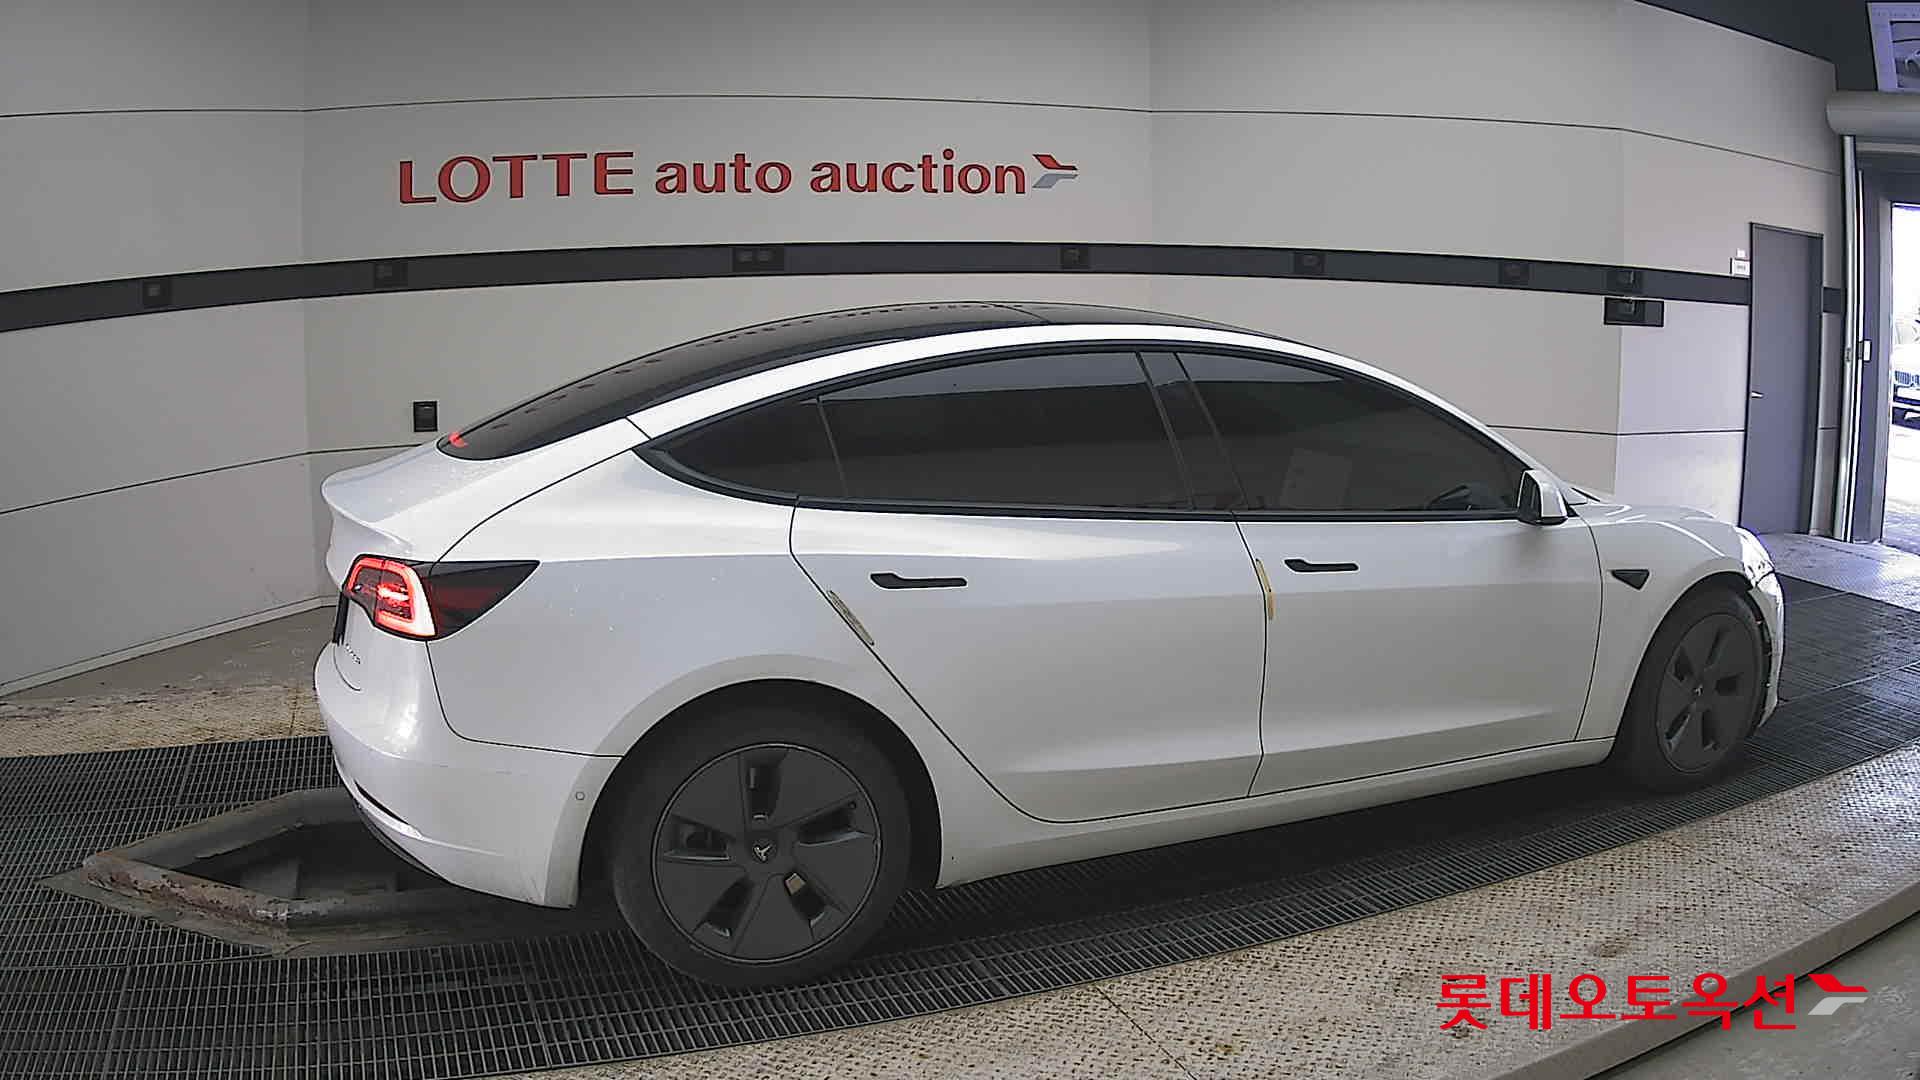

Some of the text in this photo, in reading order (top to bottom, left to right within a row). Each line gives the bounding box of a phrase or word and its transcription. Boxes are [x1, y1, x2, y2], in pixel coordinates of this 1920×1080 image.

[399, 148, 1027, 204] LOTTE auto auction
